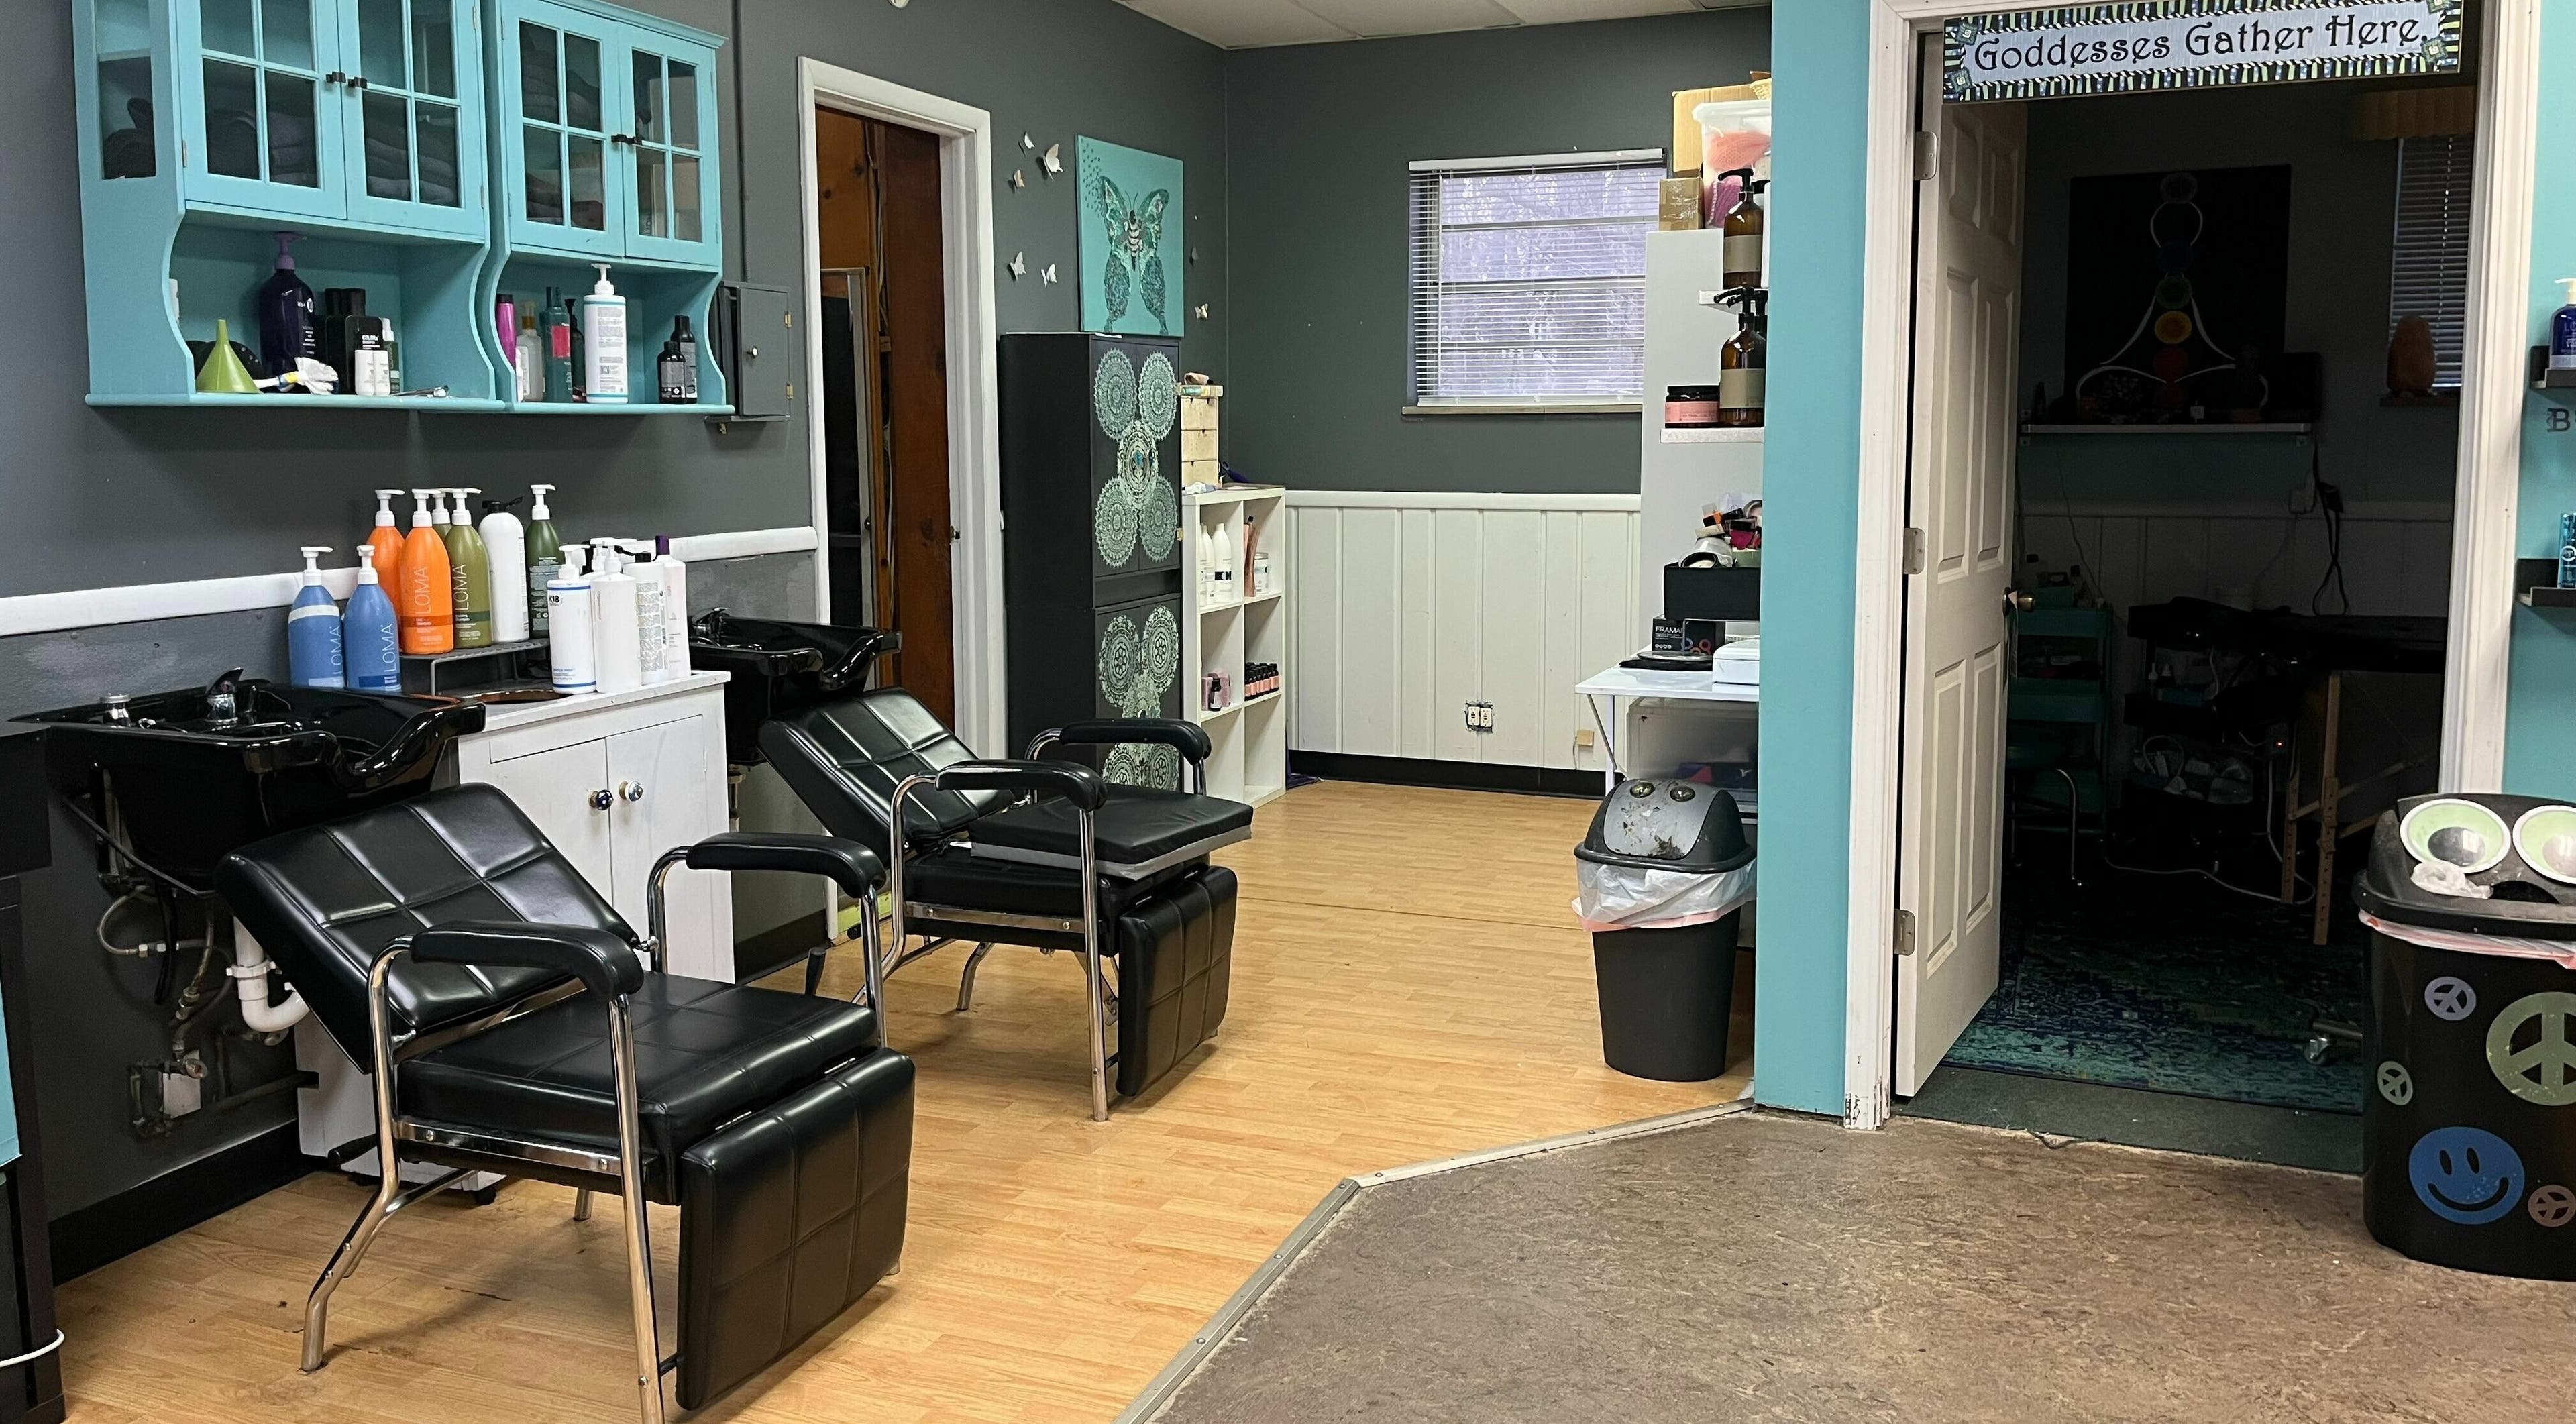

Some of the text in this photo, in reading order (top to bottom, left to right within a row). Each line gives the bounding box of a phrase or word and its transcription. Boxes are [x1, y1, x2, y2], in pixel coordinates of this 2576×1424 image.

[1974, 13, 2428, 70] Goddesses Gather Here.
[452, 563, 469, 610] LOMA
[380, 623, 396, 672] LOMA
